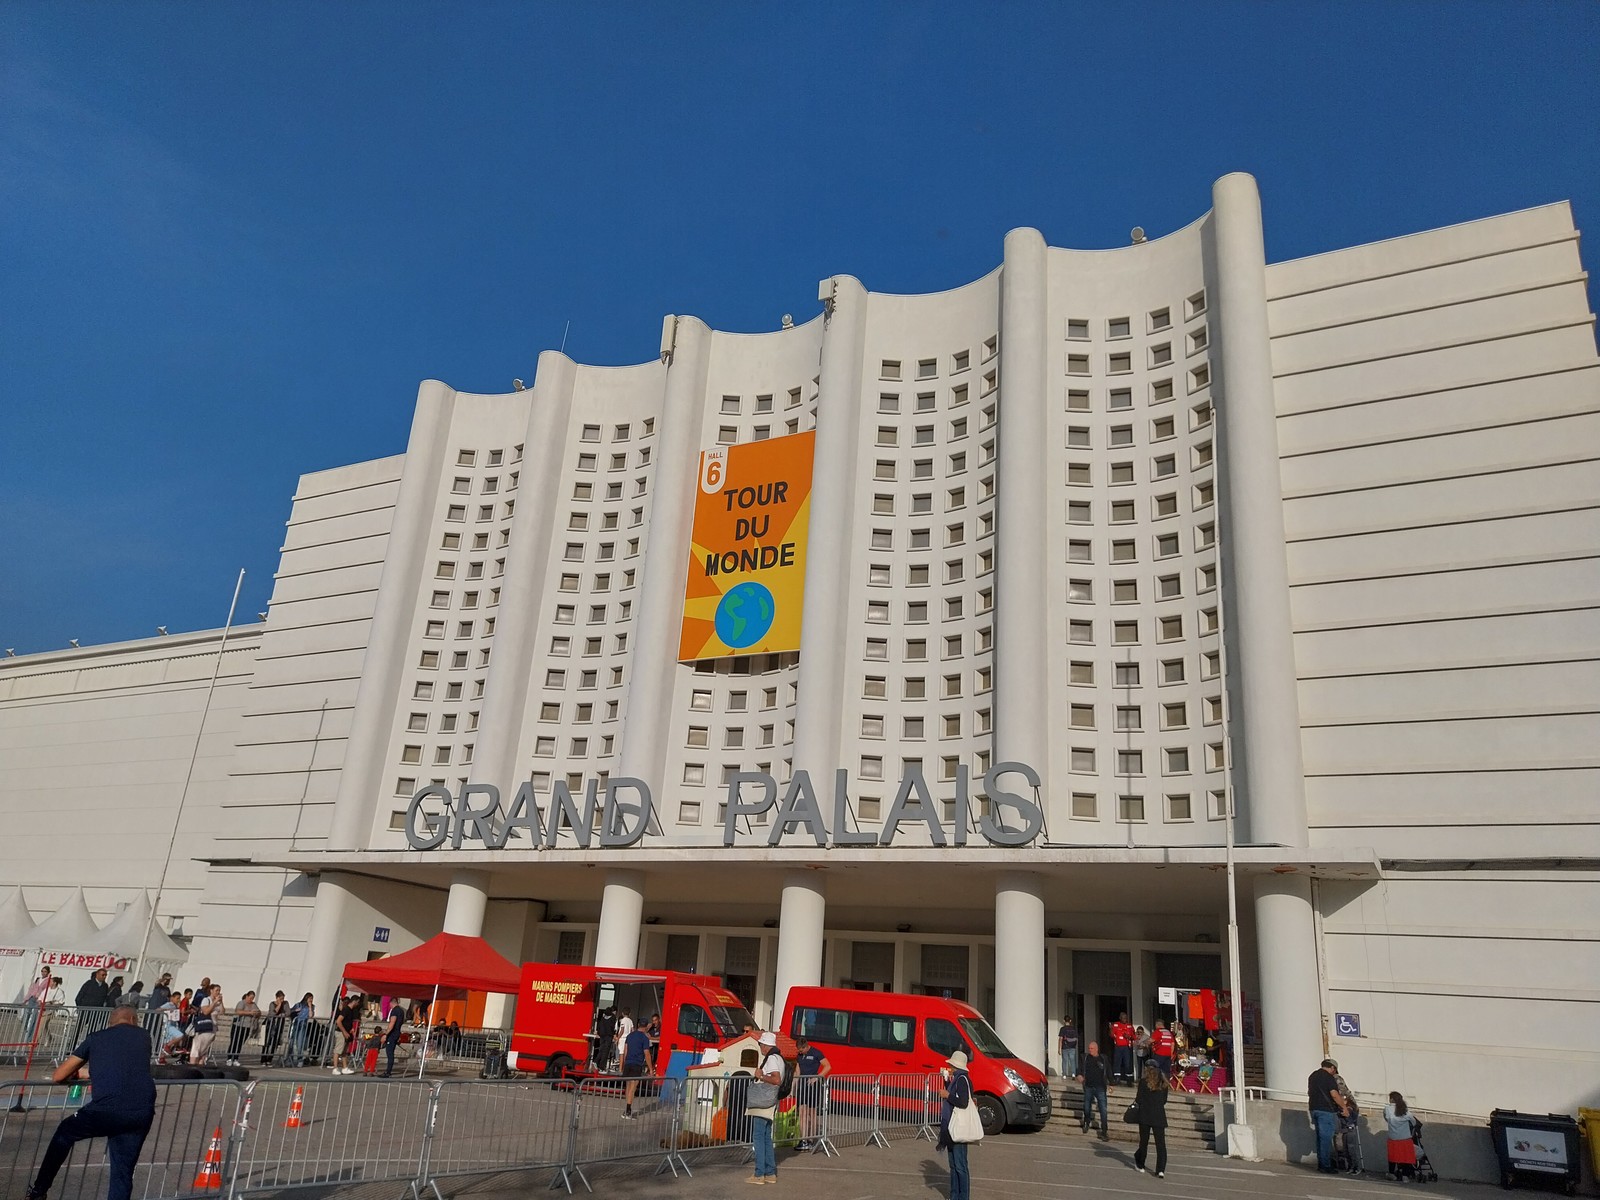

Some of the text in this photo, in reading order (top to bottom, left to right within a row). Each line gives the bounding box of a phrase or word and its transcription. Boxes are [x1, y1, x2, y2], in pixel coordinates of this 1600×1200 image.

[708, 451, 723, 460] HALL
[707, 462, 721, 485] 6
[724, 481, 788, 511] TOUR
[735, 514, 770, 541] DU
[705, 542, 795, 576] MONDE
[405, 761, 1043, 850] GRAND PALAIS
[41, 952, 56, 965] LE
[532, 981, 582, 993] MARINS POMPIERS
[536, 992, 576, 1004] DE MARSEILLE
